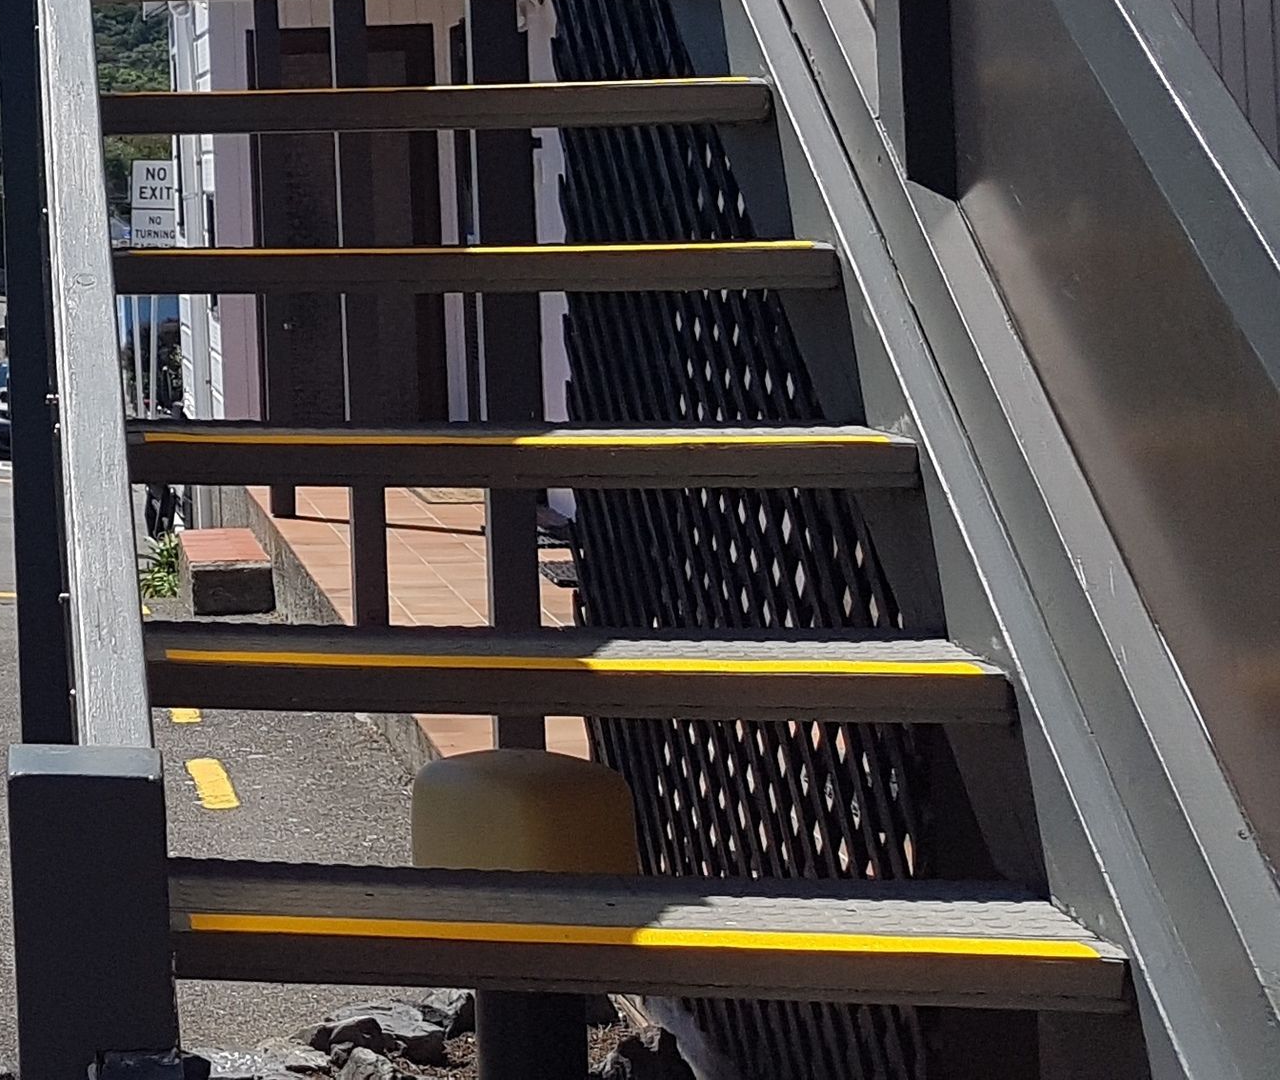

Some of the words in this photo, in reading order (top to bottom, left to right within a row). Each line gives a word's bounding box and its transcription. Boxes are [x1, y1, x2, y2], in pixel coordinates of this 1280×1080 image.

[145, 167, 167, 181] NO
[139, 186, 173, 200] EXIT
[148, 216, 162, 225] NO
[135, 228, 176, 240] TURNING
